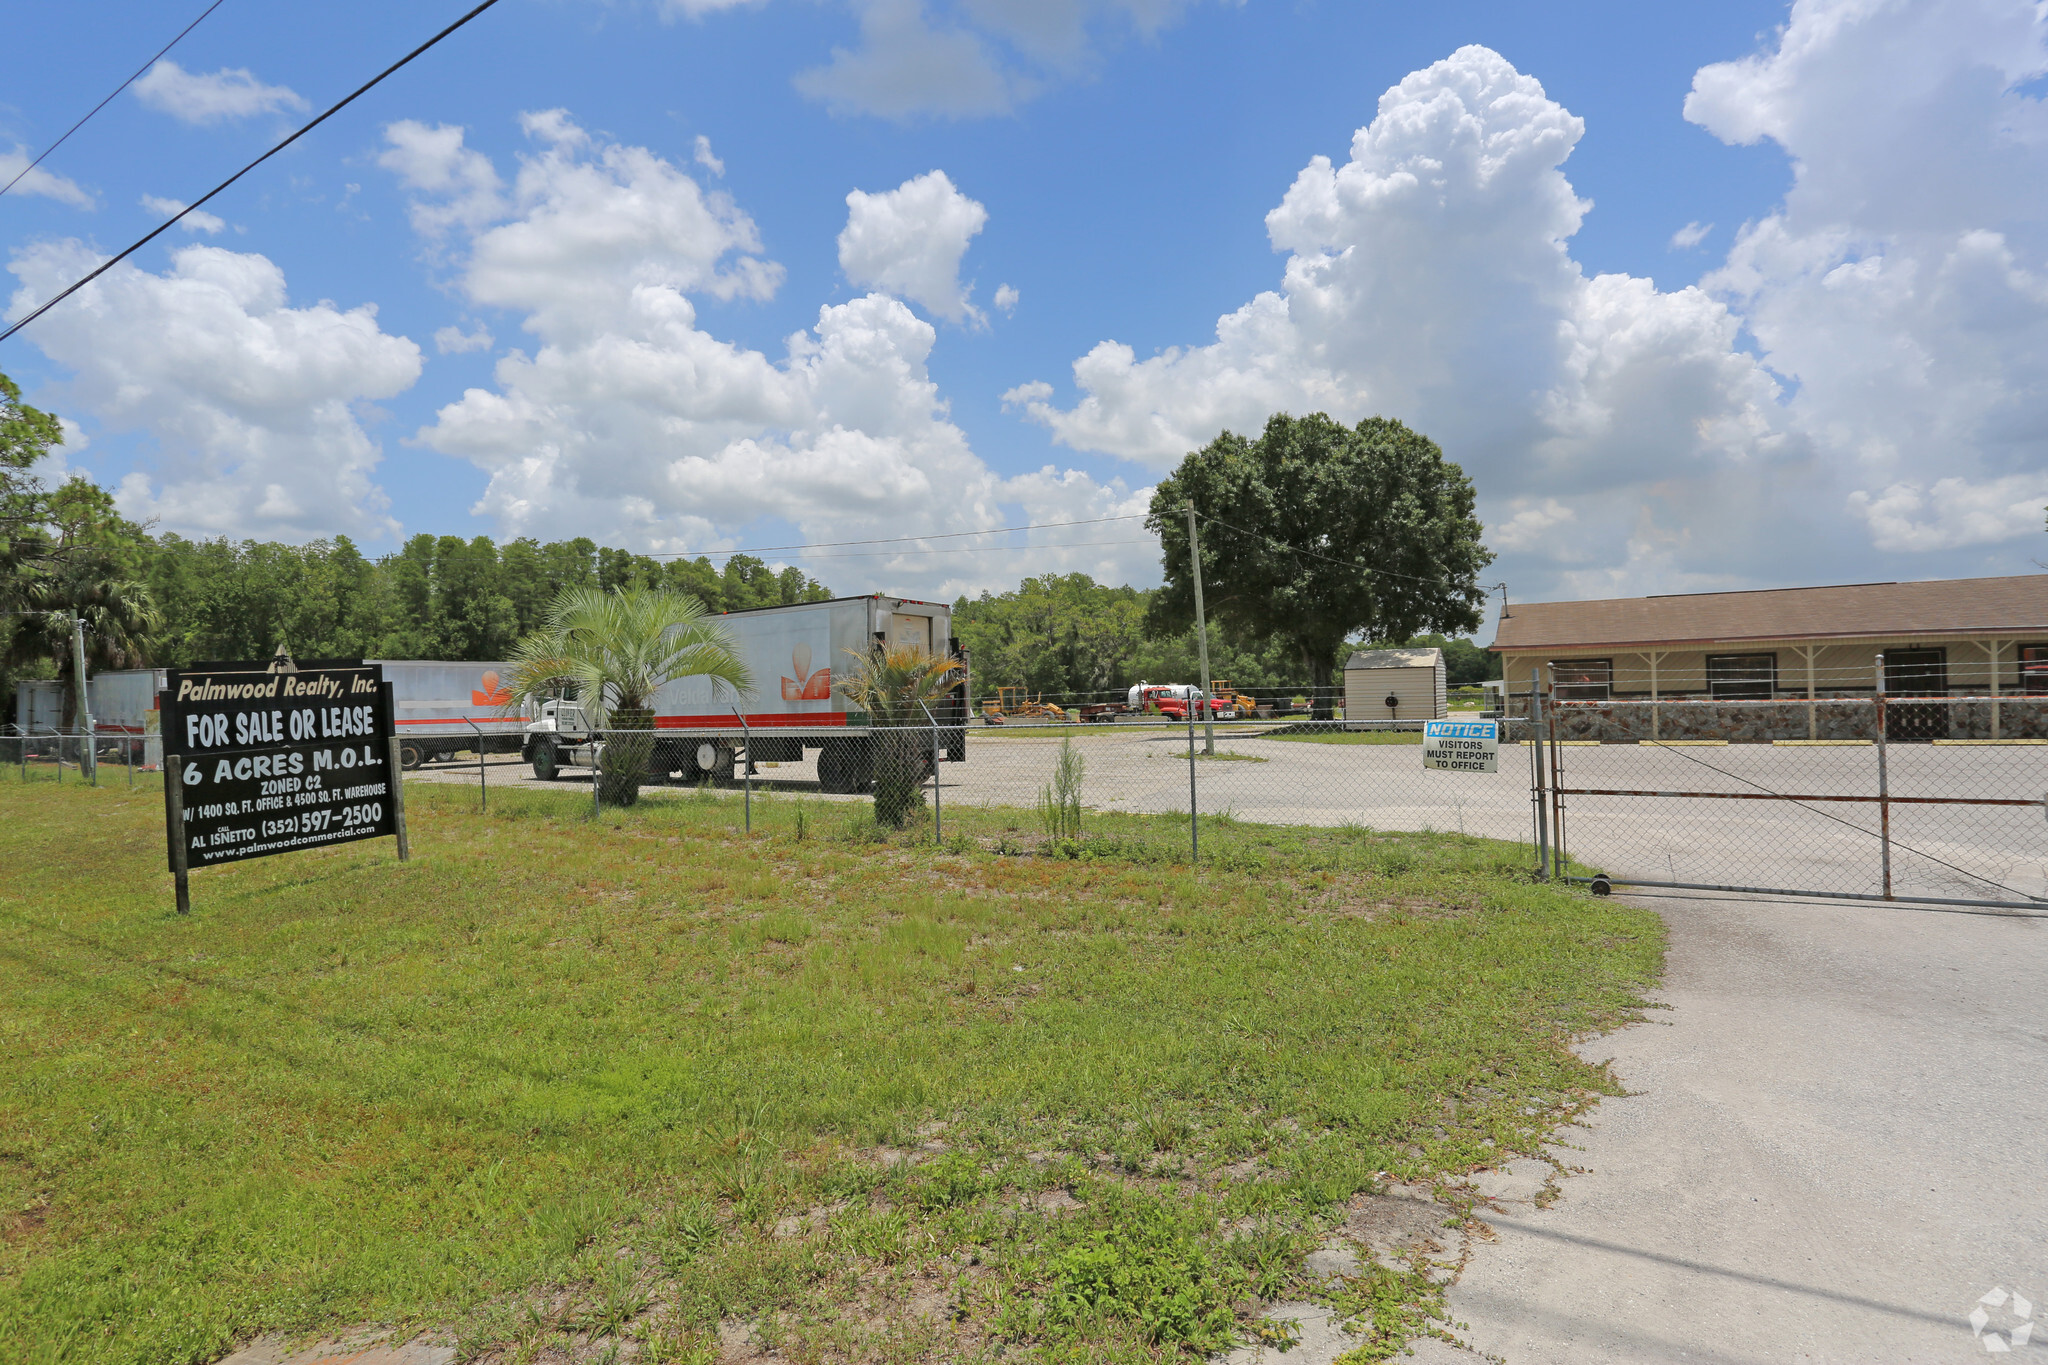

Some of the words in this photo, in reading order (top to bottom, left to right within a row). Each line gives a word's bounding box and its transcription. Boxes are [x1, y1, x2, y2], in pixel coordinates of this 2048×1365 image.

[177, 676, 278, 702] Palmwood
[283, 674, 344, 699] Realty,
[351, 674, 377, 694] Inc.
[186, 713, 229, 748] FOR
[235, 710, 284, 745] SALE
[289, 708, 316, 740] OR
[321, 705, 374, 737] LEASE
[1428, 723, 1494, 737] NOTICE
[1427, 750, 1454, 758] MUST
[1456, 751, 1495, 760] REPORT
[1438, 740, 1483, 750] VISITORS
[183, 762, 203, 786] 6
[213, 753, 304, 783] ACRES
[313, 746, 383, 772] M.O.L.
[1436, 760, 1448, 768] TO
[1451, 762, 1485, 770] OFFICE
[260, 777, 302, 796] ZONED
[305, 775, 322, 790] C2
[198, 804, 223, 819] 1400
[224, 802, 240, 816] SQ.
[242, 800, 254, 814] FT.
[256, 796, 284, 812] OFFICE
[286, 796, 293, 808] &
[294, 792, 317, 807] 4500
[318, 790, 331, 803] SQ.
[332, 788, 344, 802] FT.
[344, 783, 386, 799] WAREHOUSE
[191, 836, 206, 849] AL
[210, 828, 256, 846] ISNETTO
[262, 816, 298, 838] (352)
[301, 802, 382, 833] 597-2500
[203, 825, 375, 860] www.palmwoodcommercial.com
